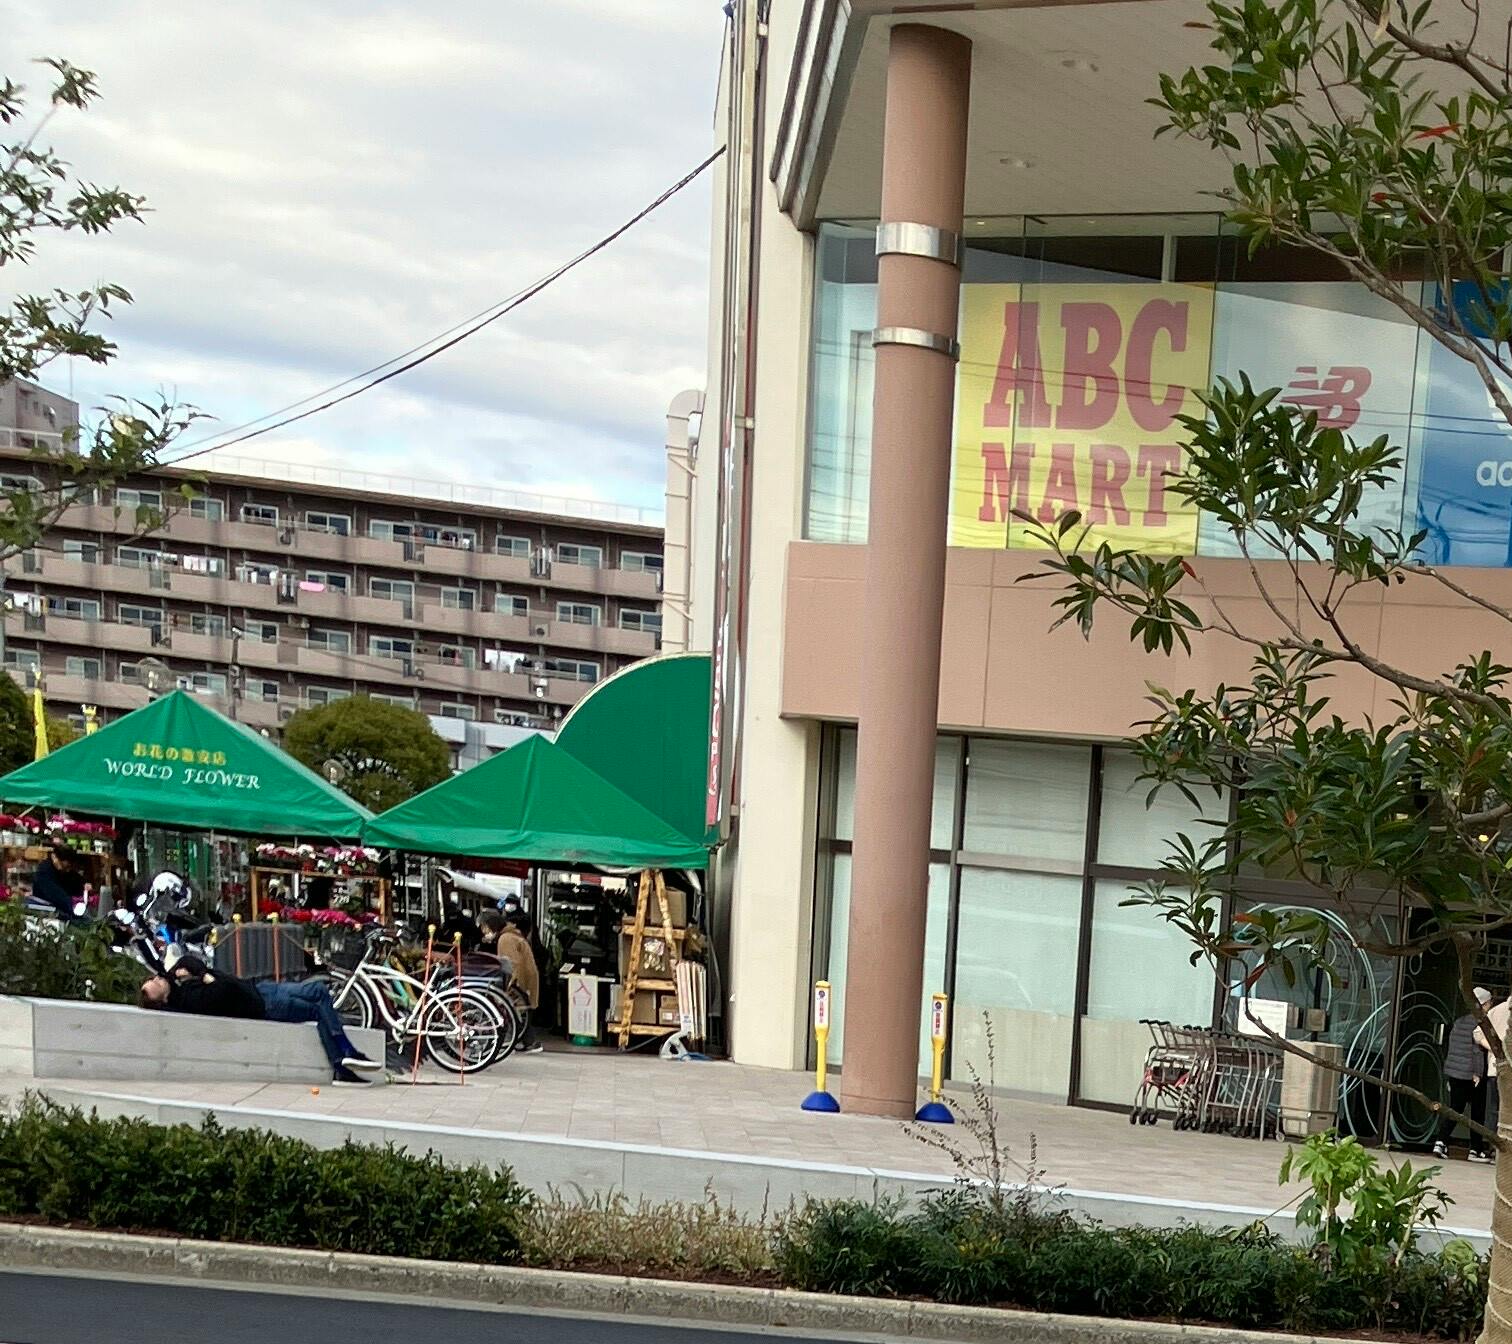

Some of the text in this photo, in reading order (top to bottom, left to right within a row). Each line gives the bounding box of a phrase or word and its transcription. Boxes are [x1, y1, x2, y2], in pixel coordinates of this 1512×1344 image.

[983, 297, 1189, 432] ABC
[978, 441, 1181, 528] MART
[104, 757, 261, 790] WORLD FLOWER
